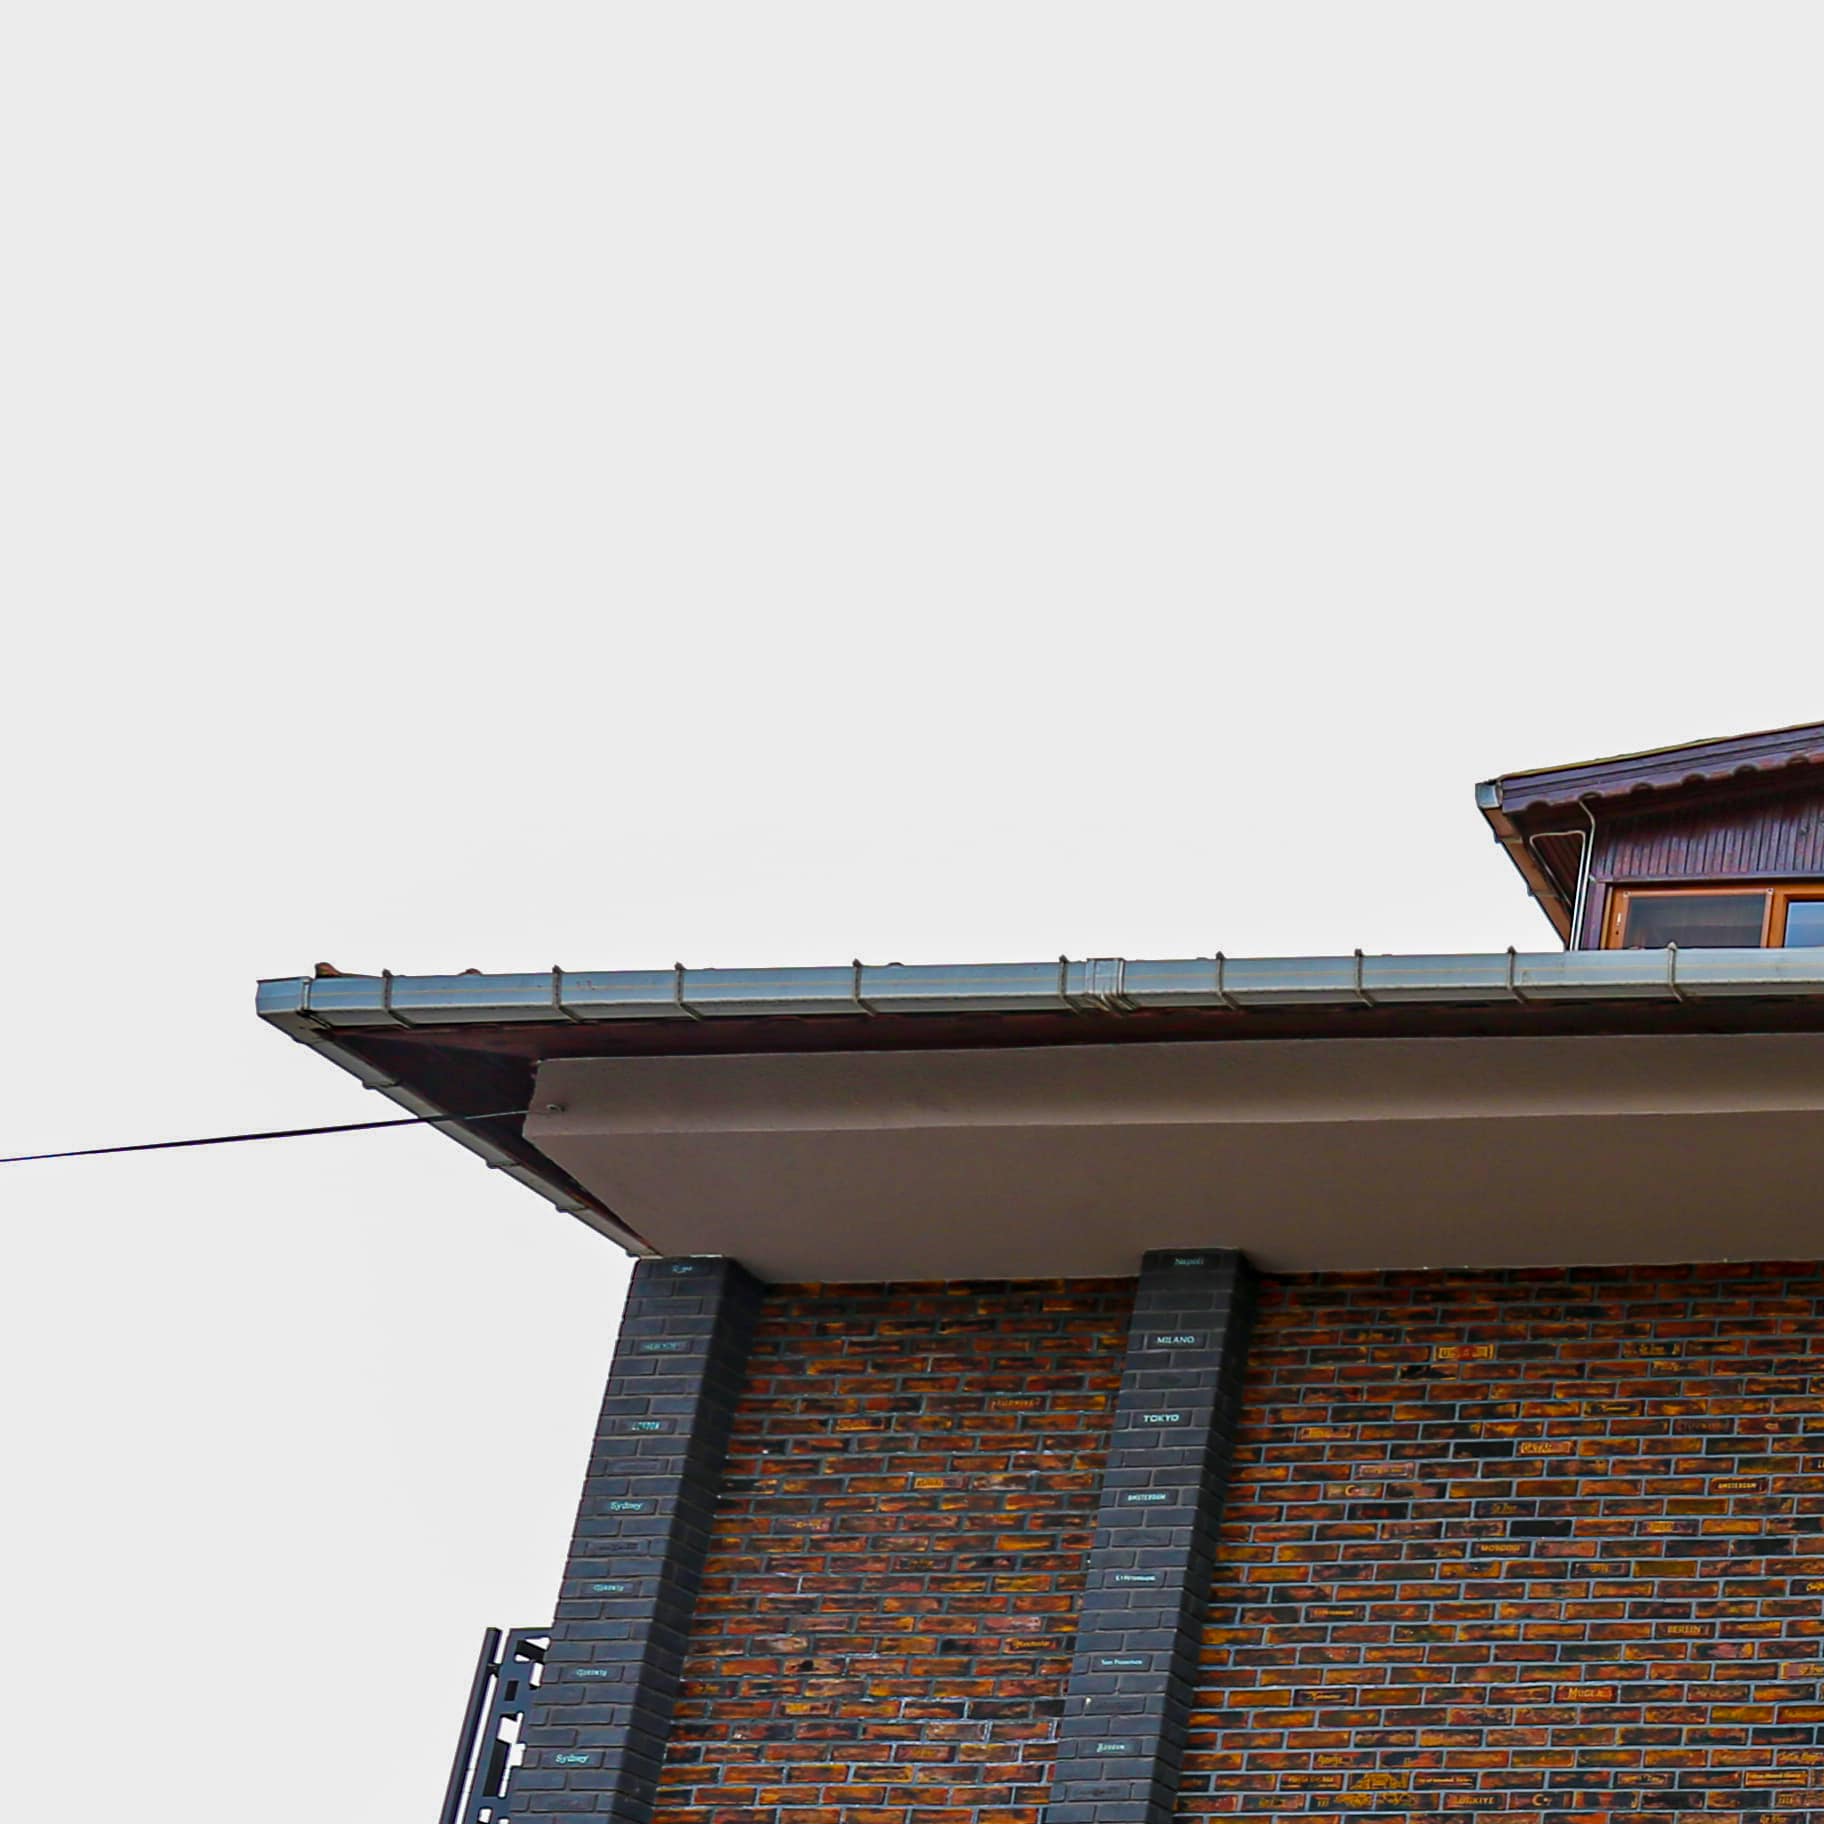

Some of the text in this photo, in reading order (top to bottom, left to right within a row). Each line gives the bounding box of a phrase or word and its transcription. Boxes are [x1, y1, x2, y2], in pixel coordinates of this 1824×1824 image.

[1156, 1335, 1195, 1344] MILANO
[1143, 1413, 1179, 1423] TOKYO
[610, 1500, 641, 1512] Sydney
[555, 1753, 589, 1764] Sydney
